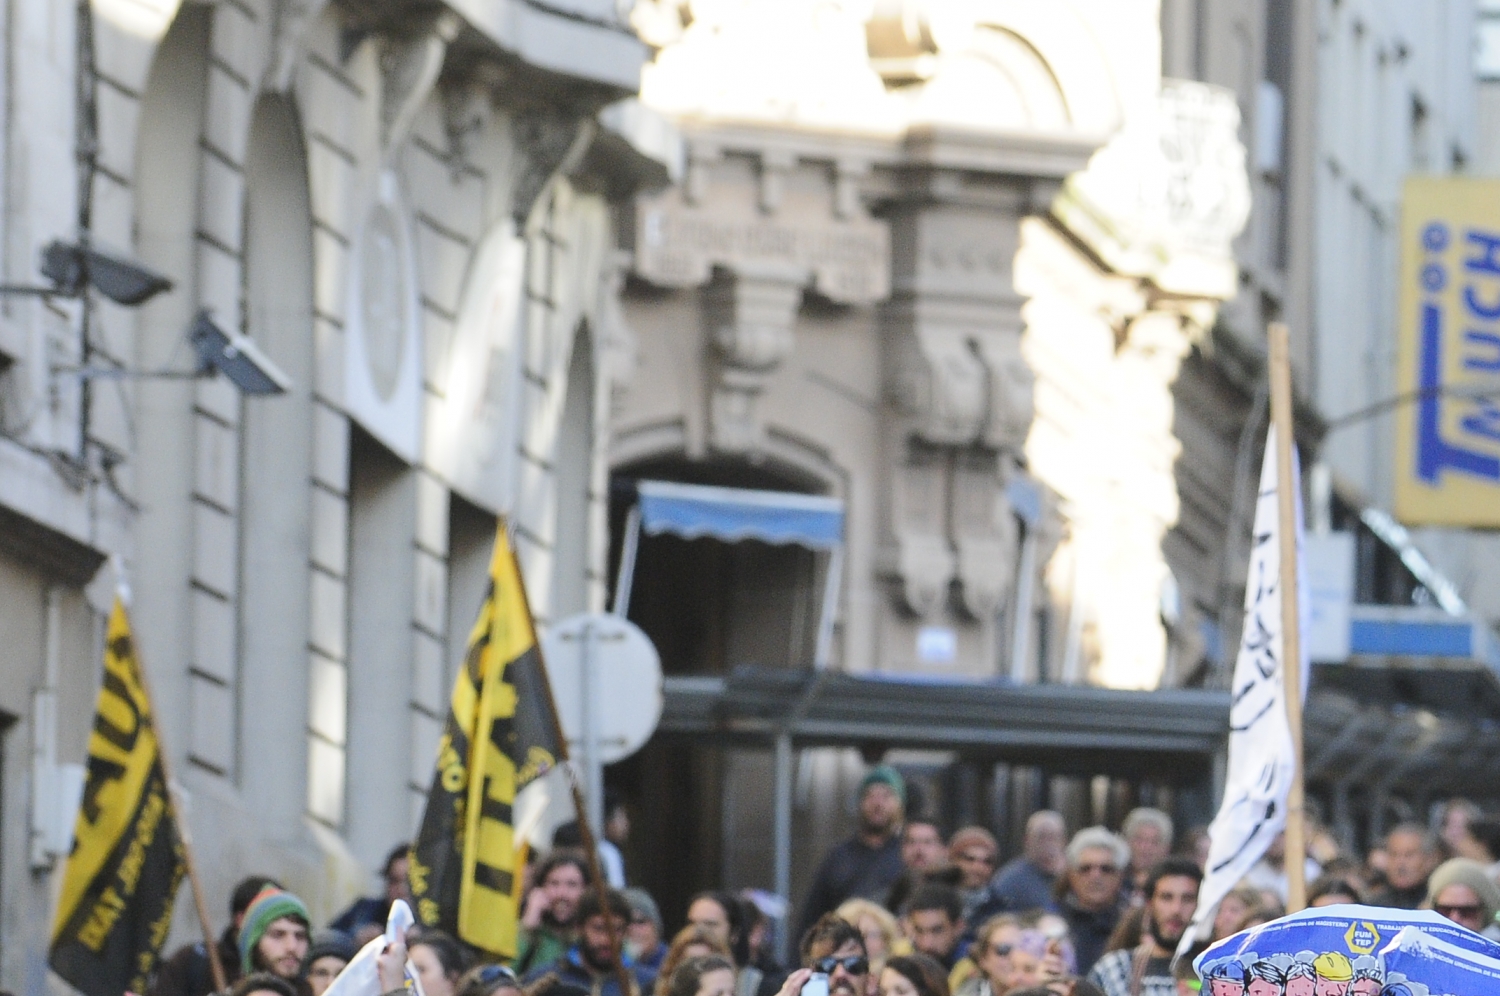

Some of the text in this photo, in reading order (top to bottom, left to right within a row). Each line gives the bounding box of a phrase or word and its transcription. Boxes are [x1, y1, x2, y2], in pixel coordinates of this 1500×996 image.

[1315, 920, 1349, 928] MAGISTERIO
[1354, 931, 1373, 939] FUM
[1354, 938, 1372, 947] TEP
